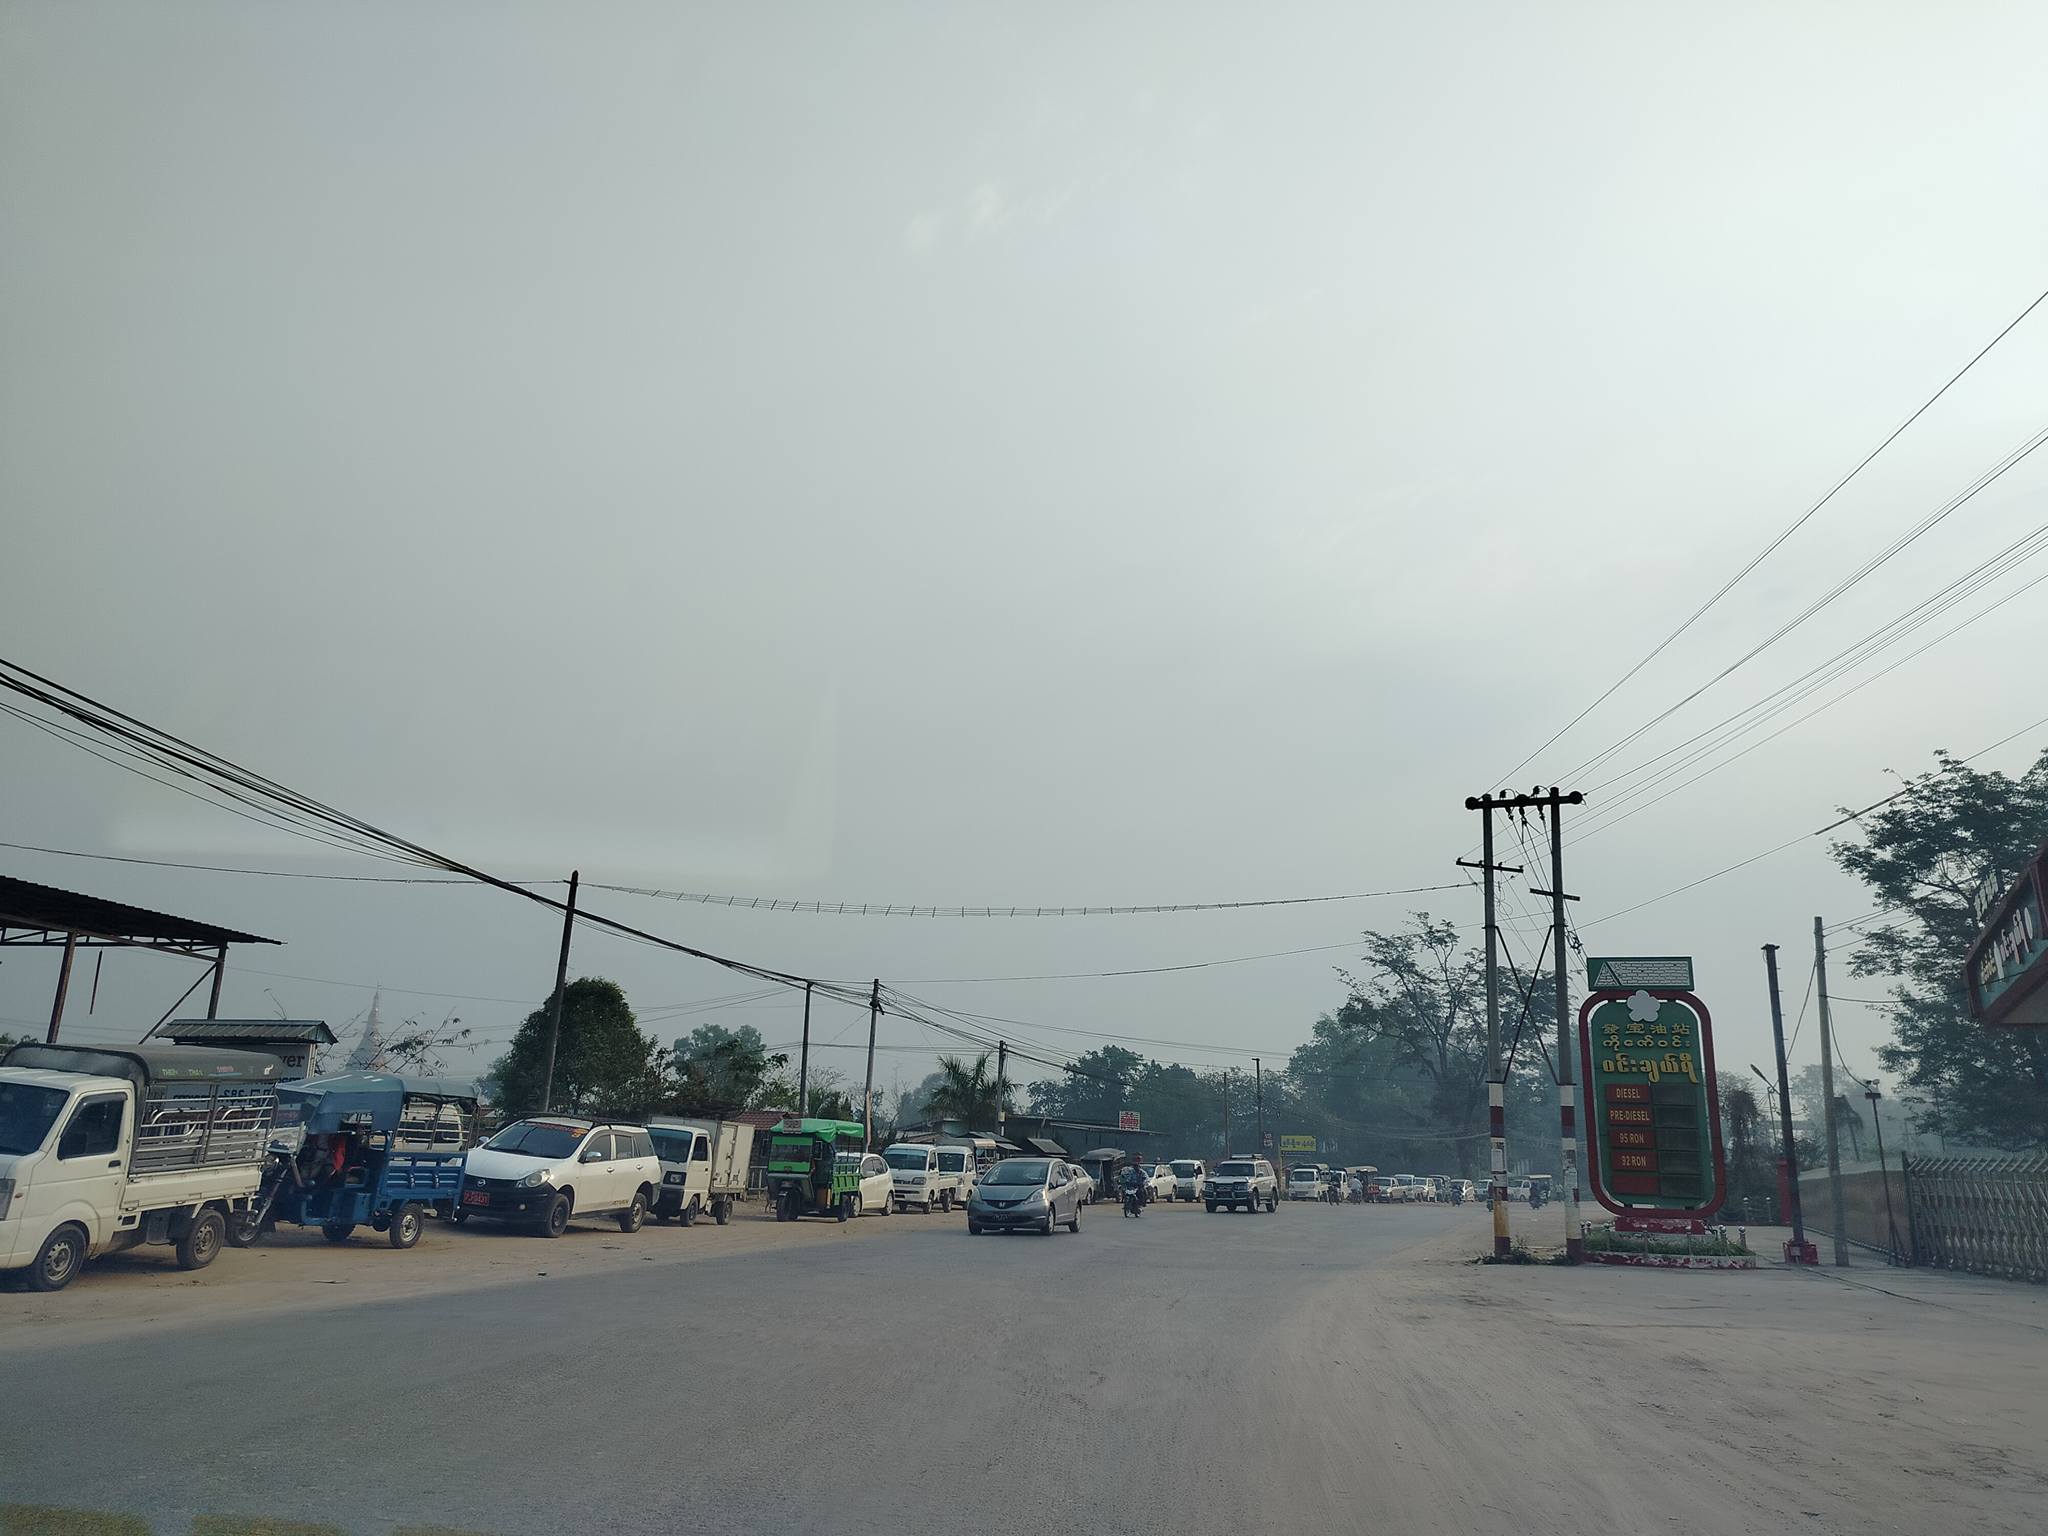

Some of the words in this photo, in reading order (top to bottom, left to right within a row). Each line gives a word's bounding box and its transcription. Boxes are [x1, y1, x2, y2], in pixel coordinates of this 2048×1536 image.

[1616, 1088, 1641, 1099] DIESEL
[1610, 1110, 1651, 1121] PRE-DIESEL
[1619, 1133, 1629, 1144] 95
[1629, 1133, 1645, 1144] RON
[1622, 1155, 1631, 1166] 92
[1631, 1155, 1647, 1167] RON
